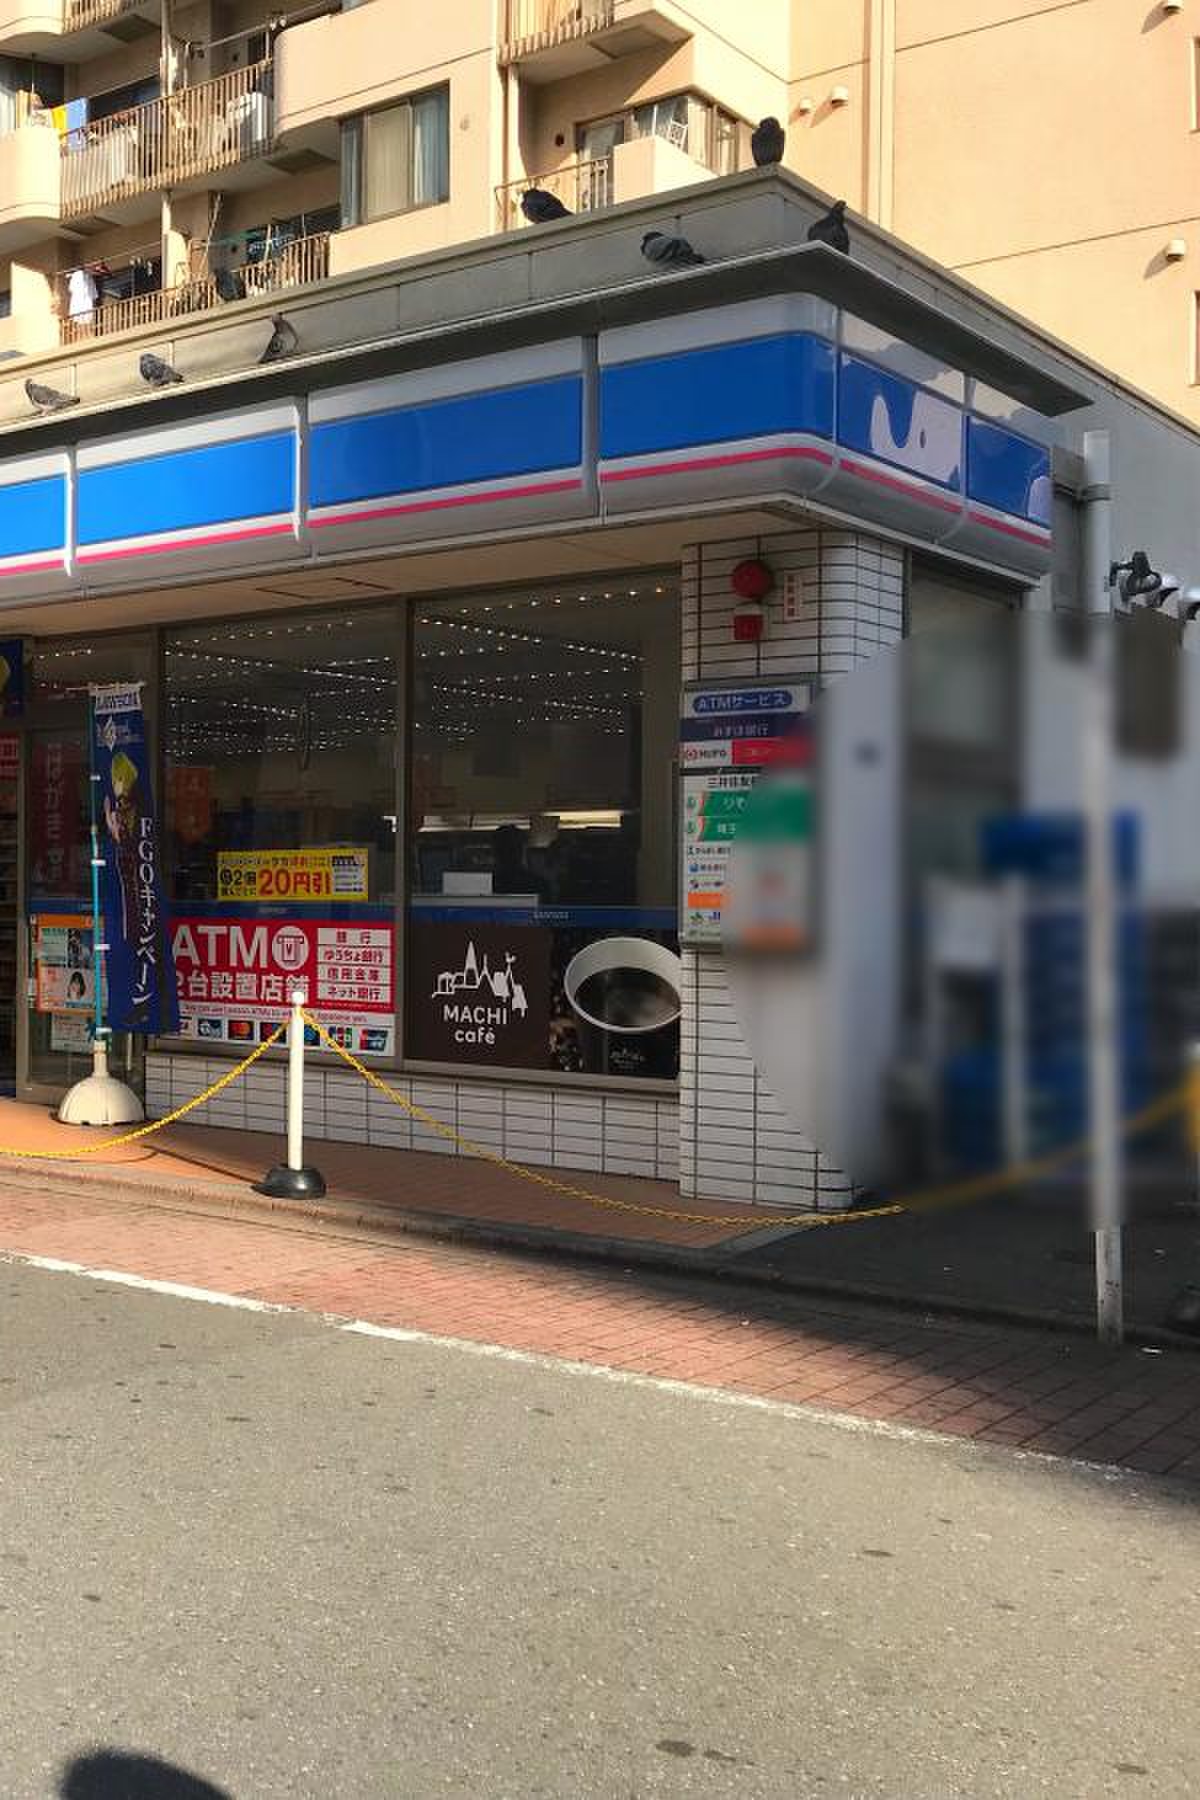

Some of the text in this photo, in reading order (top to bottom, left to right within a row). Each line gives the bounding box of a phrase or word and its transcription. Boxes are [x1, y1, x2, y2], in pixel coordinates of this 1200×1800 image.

[132, 817, 157, 1005] FGOキャンペーン
[172, 924, 269, 969] ATM
[443, 1004, 507, 1025] MACHI
[455, 1026, 496, 1045] café
